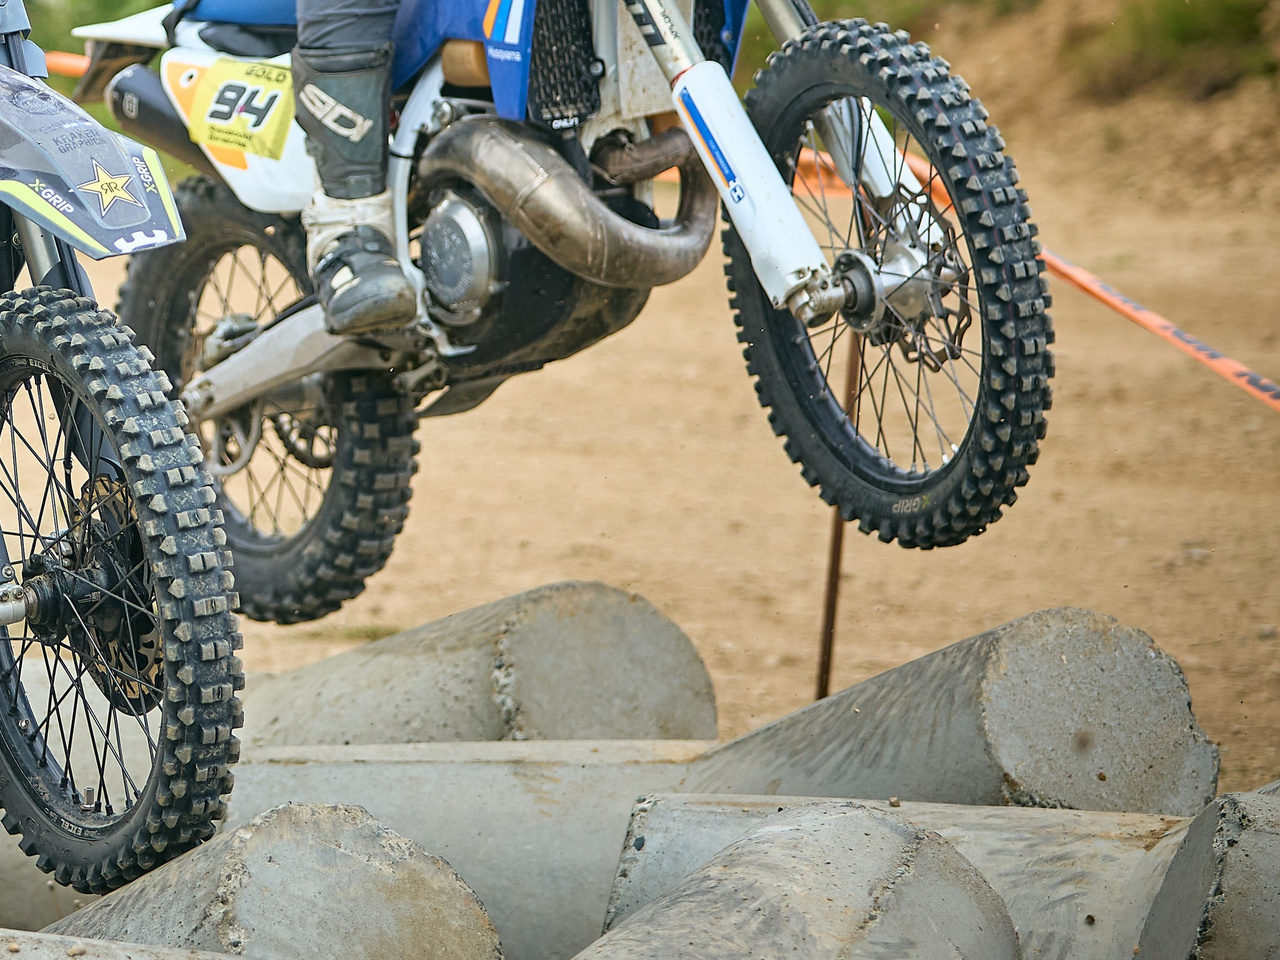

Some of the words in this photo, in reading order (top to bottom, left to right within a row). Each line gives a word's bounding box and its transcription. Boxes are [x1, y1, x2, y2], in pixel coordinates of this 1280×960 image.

[245, 65, 287, 83] GOLD
[209, 84, 279, 128] 94
[52, 128, 101, 147] KRAKEN
[28, 178, 75, 214] X-GRIP
